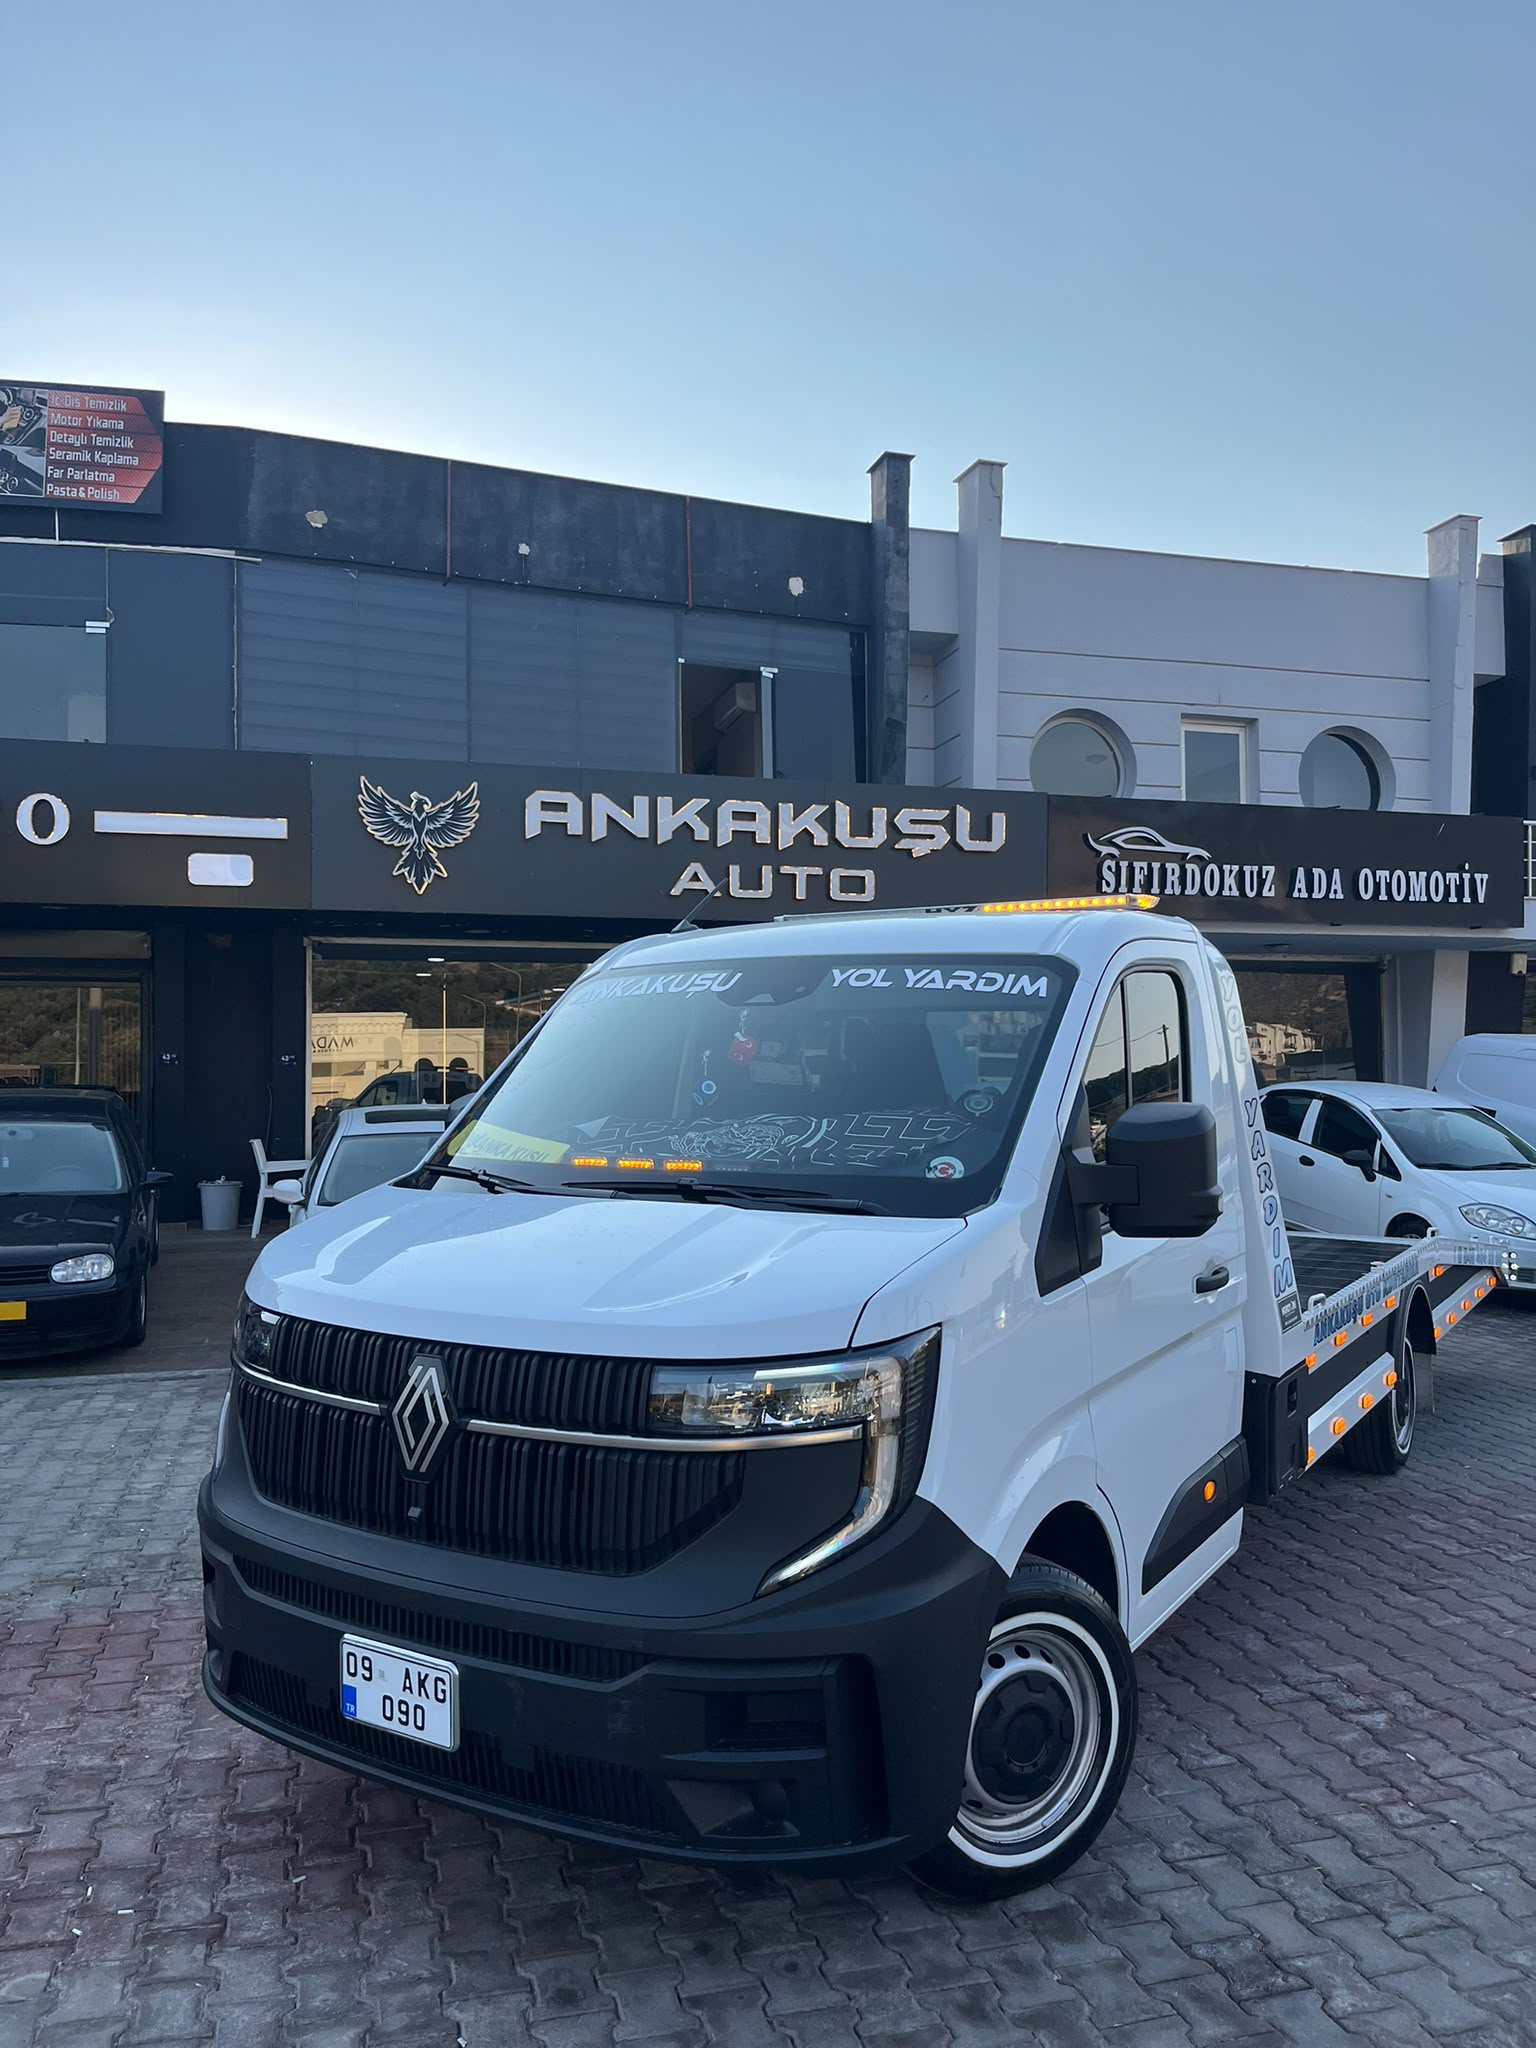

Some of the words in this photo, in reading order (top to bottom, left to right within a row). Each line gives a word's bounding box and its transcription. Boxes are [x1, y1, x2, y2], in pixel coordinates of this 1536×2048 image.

[85, 396, 127, 412] Temizlik
[51, 412, 82, 427] Motor
[86, 415, 124, 430] Yıkama
[50, 430, 87, 447] Detaylı
[91, 433, 134, 449] Temizlik
[49, 447, 91, 462] Seramik
[94, 451, 139, 467] Kaplama
[47, 465, 64, 479] Far
[67, 468, 115, 483] Parlatma
[87, 486, 120, 500] Polish
[525, 789, 1006, 858] ANKAKUŞU
[669, 861, 876, 902] AUTO
[1101, 858, 1276, 898] SIFIRDOKUZ
[1292, 866, 1344, 900] ADA
[1357, 862, 1489, 904] OTOMOTİV
[831, 968, 893, 988] YOL
[903, 968, 1049, 998] YARDIM
[1218, 974, 1247, 1064] YOL
[1244, 1098, 1293, 1298] YARDIM
[346, 1651, 373, 1682] 09
[402, 1667, 447, 1704] AKG
[346, 1703, 356, 1714] TR
[382, 1694, 425, 1731] 090
